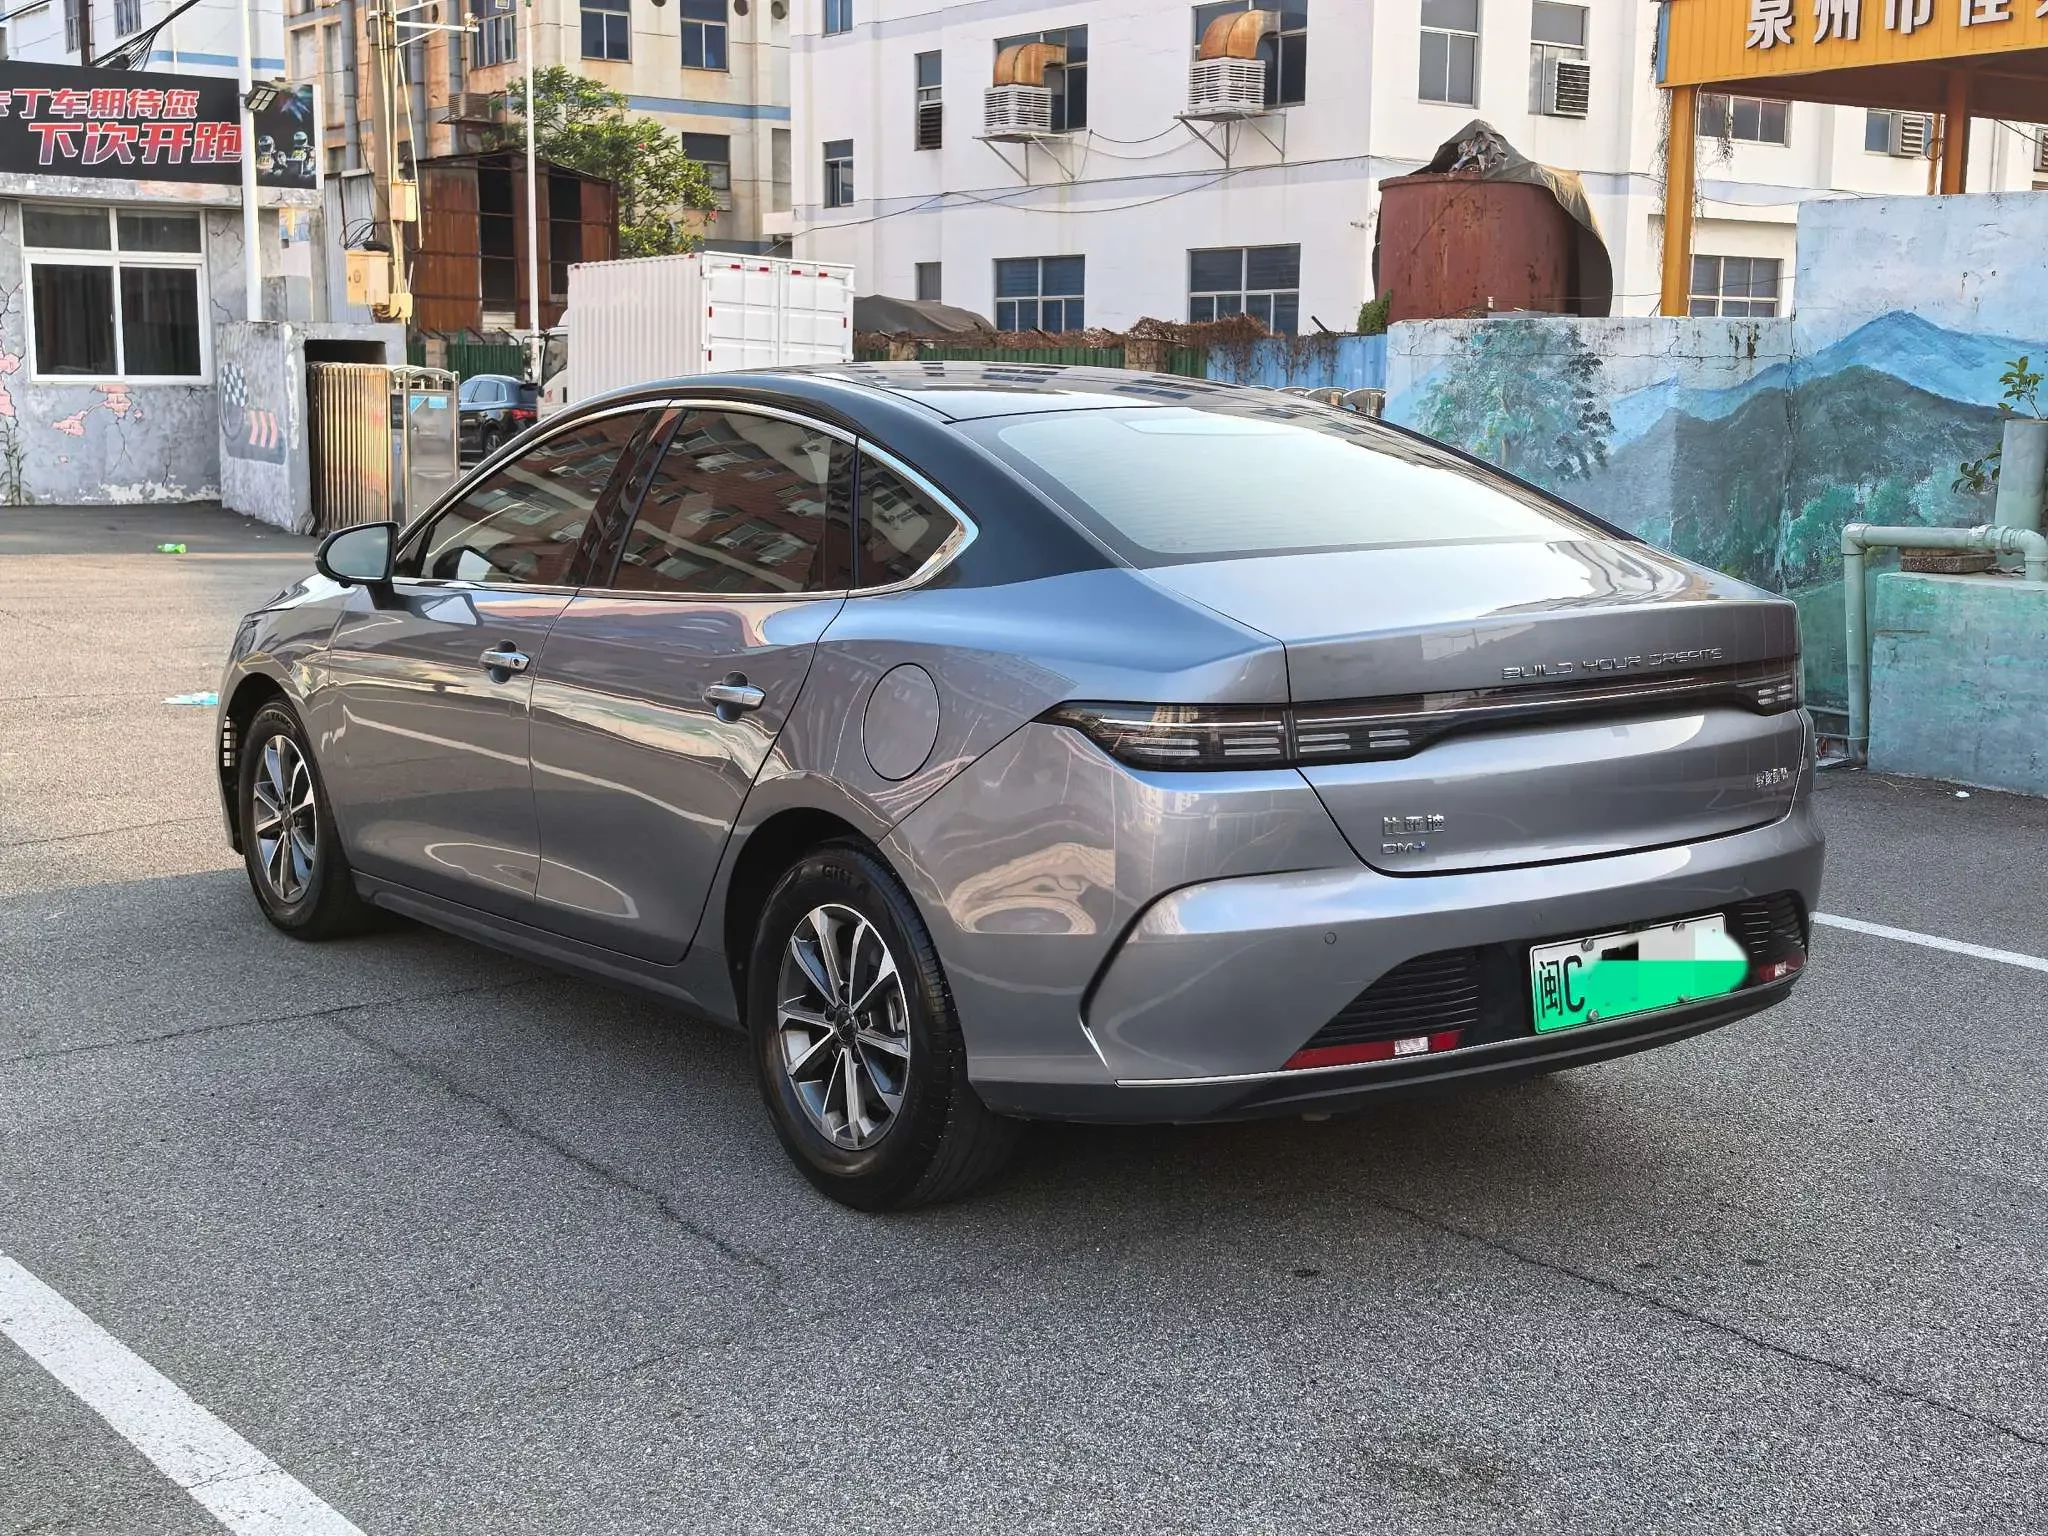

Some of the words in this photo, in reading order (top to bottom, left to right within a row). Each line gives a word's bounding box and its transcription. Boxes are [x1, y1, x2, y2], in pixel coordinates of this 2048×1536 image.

[28, 122, 242, 165] 下次开跑
[1502, 662, 1575, 680] BUILD
[1582, 655, 1641, 672] YOUR
[1648, 647, 1723, 667] DREAMS
